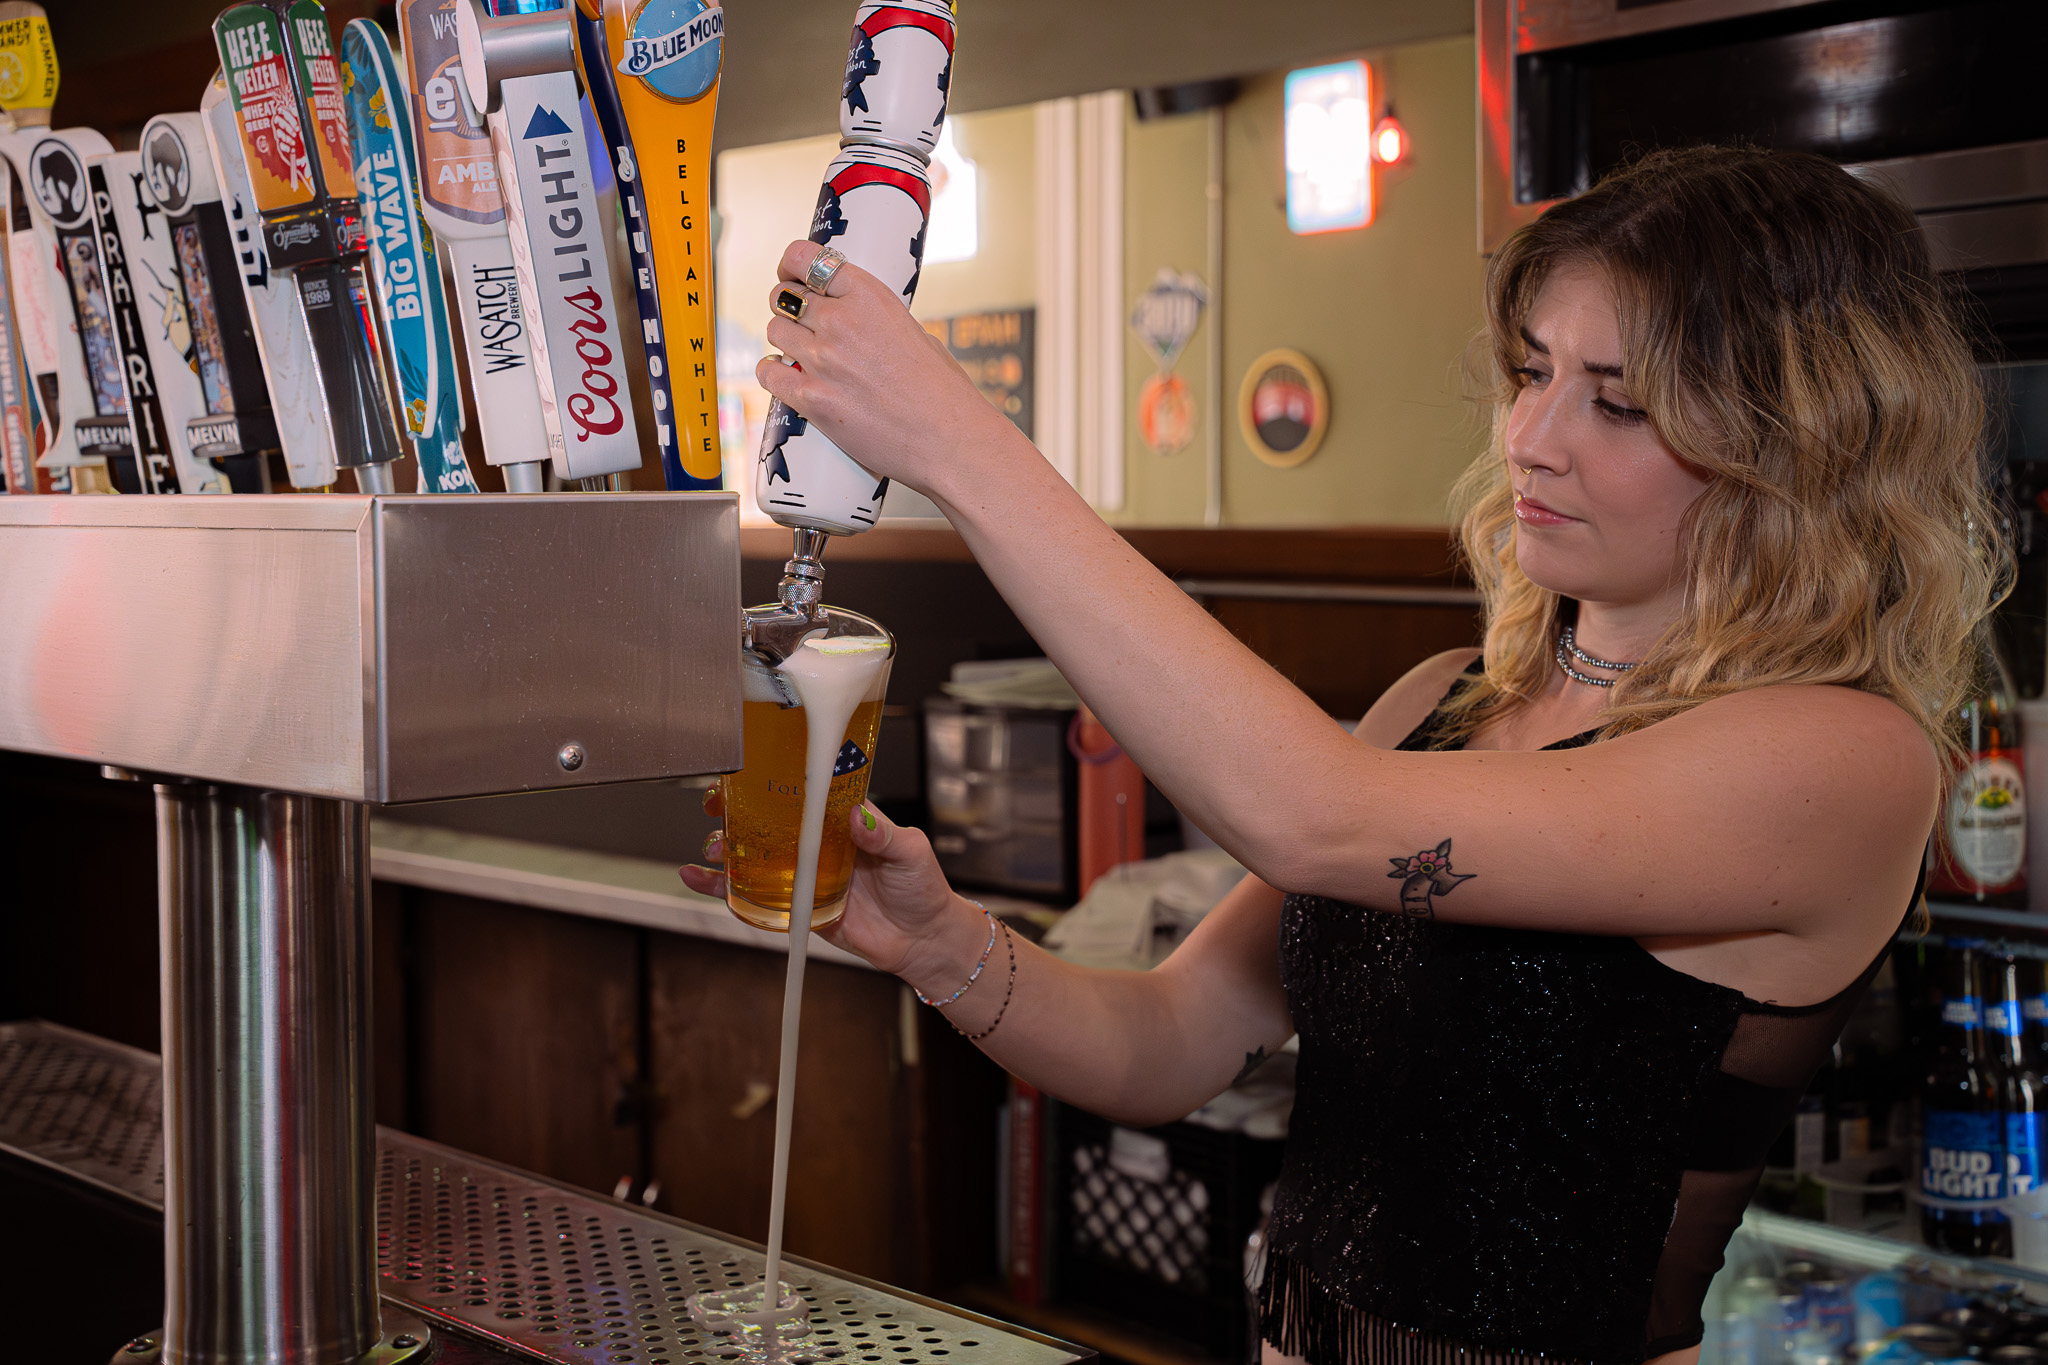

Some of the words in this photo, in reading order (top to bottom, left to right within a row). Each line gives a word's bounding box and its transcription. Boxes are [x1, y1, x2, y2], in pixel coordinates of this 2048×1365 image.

[224, 20, 274, 69] HEFE
[295, 18, 331, 56] HEFE
[628, 32, 687, 73] BLUE
[689, 13, 724, 47] MOON
[234, 62, 280, 97] WEIZEN
[305, 59, 338, 84] WEIZEN
[242, 100, 277, 121] WHEAT
[245, 117, 271, 133] BEER
[372, 149, 408, 254] WAVE
[472, 181, 498, 194] ALE
[535, 143, 593, 283] LIGHT
[304, 289, 331, 306] 1989
[389, 257, 422, 320] BIG
[506, 281, 521, 320] BREWERY
[616, 145, 652, 290] BLUE
[642, 318, 671, 447] MOON
[676, 138, 700, 306] BELGIAN
[689, 337, 712, 452] WHITE
[472, 265, 527, 375] WASATCH
[94, 190, 176, 494] PRAIRIE
[563, 284, 625, 443] Coors
[75, 425, 133, 448] MELVIN
[187, 422, 240, 449] MELVIN
[1928, 1147, 1992, 1175] BUD
[1922, 1171, 2002, 1198] LIGHT
